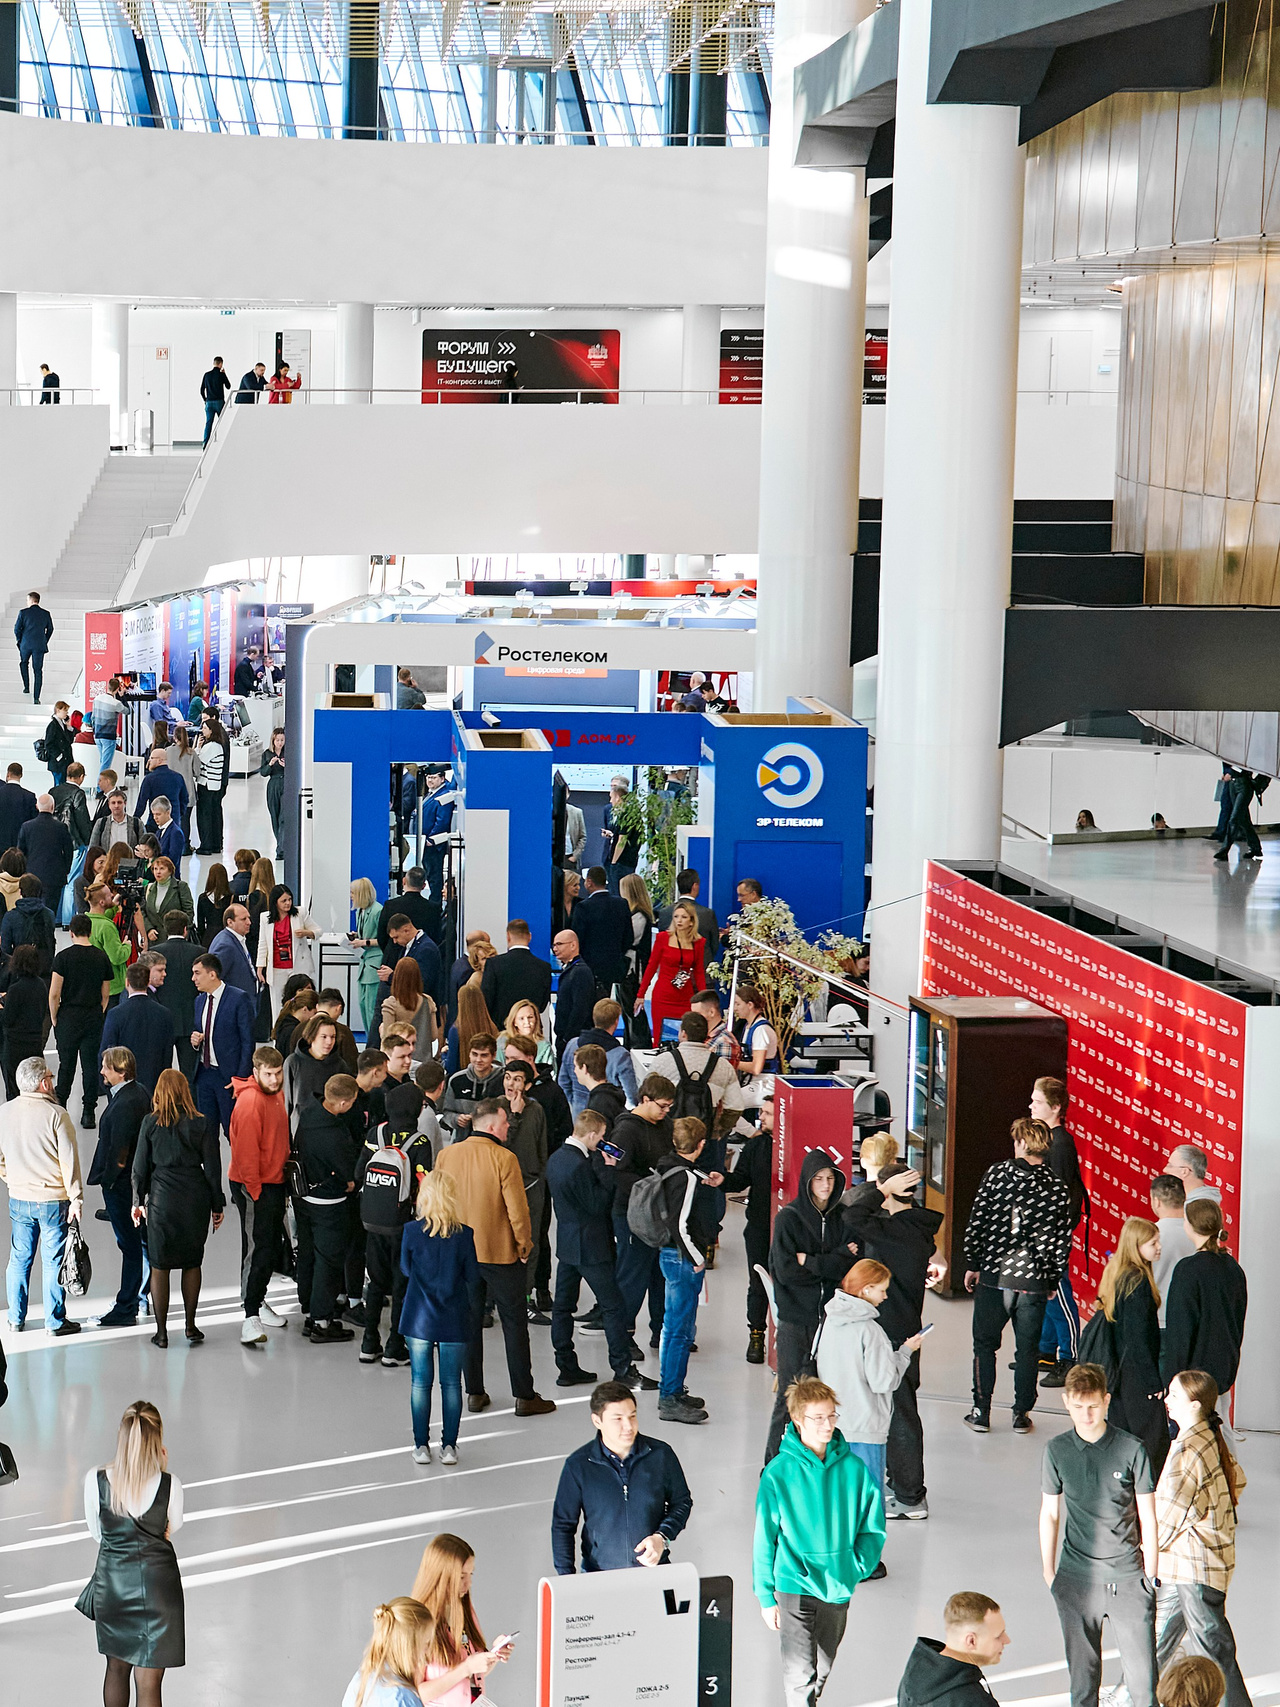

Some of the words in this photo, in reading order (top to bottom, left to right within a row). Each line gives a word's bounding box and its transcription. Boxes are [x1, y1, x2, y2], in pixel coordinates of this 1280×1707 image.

[437, 341, 489, 355] ФОРУМ
[485, 378, 502, 386] выст
[498, 646, 608, 663] Ростелеком
[577, 733, 637, 745] дом.ру
[366, 1171, 397, 1187] NASA
[705, 1599, 720, 1618] 4
[565, 1614, 594, 1623] БАЛКОН
[565, 1656, 596, 1664] Ресторан
[636, 1685, 657, 1694] ЛОЖА
[705, 1676, 718, 1695] 3
